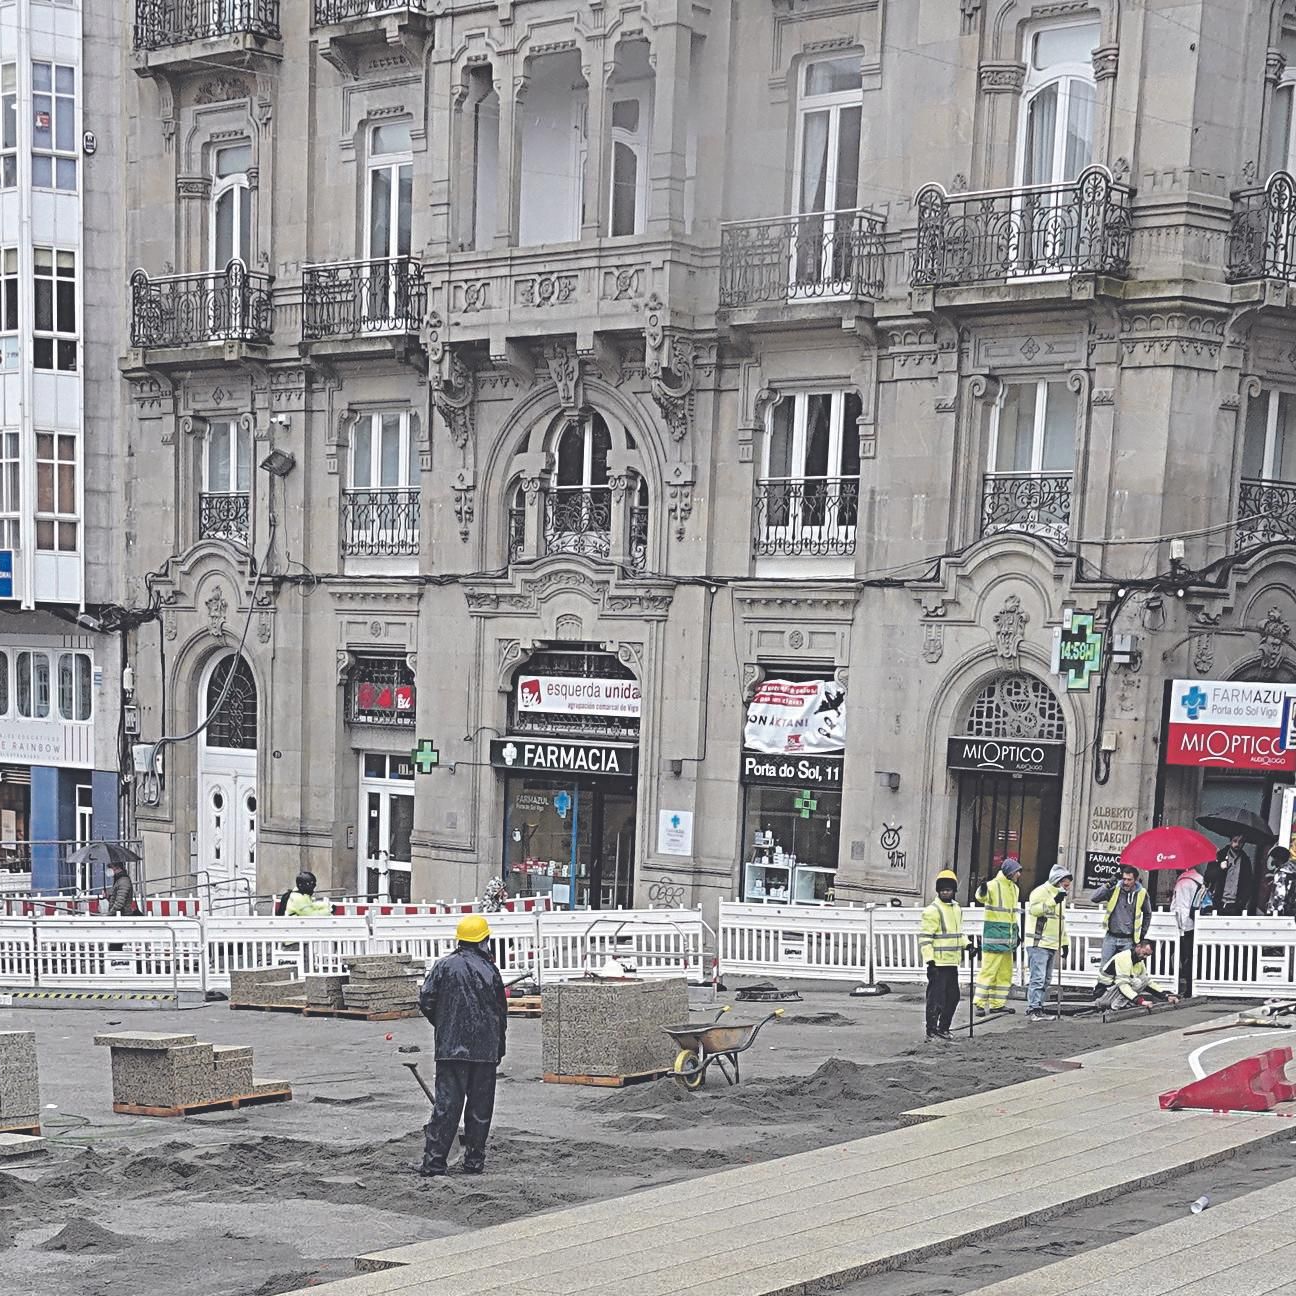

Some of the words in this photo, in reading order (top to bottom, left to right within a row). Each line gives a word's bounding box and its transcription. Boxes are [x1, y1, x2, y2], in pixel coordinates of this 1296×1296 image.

[547, 682, 601, 700] esquerda
[605, 682, 642, 699] unida
[627, 704, 639, 713] Vigo
[1212, 704, 1232, 715] Porta
[1233, 705, 1244, 716] do
[1245, 705, 1259, 716] Sol
[1260, 706, 1278, 718] Vigo
[12, 742, 61, 754] RAINBOW
[963, 742, 1045, 763] MIOPTICO
[523, 744, 620, 772] FARMACIA
[745, 758, 777, 777] Porta
[778, 763, 795, 778] do
[797, 760, 823, 782] Sol,
[825, 766, 839, 781] 11
[516, 794, 550, 806] FARMAZUL
[1093, 806, 1134, 818] ALBERTO
[1091, 819, 1133, 832] SANCHEZ
[1088, 853, 1121, 865] FARMAC
